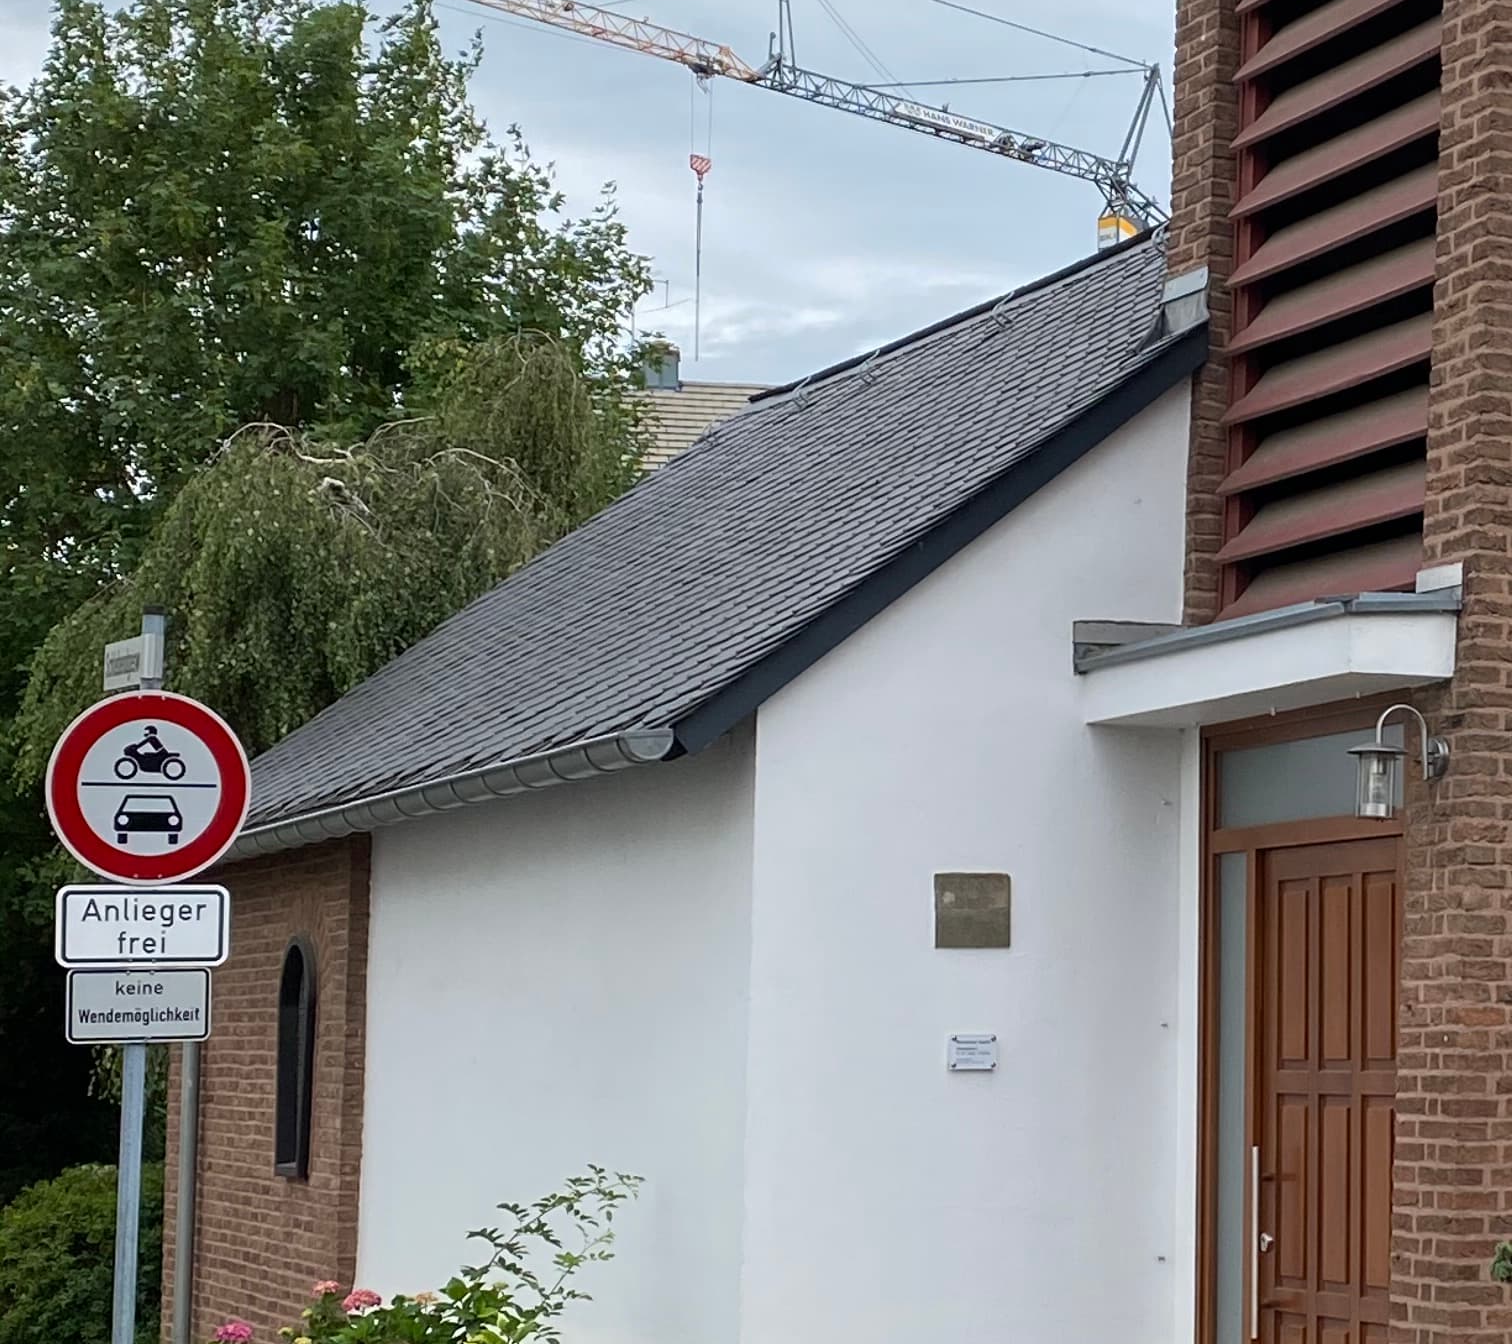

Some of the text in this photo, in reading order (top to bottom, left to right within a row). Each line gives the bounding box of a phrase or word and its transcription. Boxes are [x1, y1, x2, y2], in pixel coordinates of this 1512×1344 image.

[923, 109, 951, 125] HANS
[81, 897, 207, 927] Anlieger
[118, 930, 166, 954] frei
[115, 980, 164, 995] keine
[79, 1006, 200, 1026] Wendemöglichkeit
